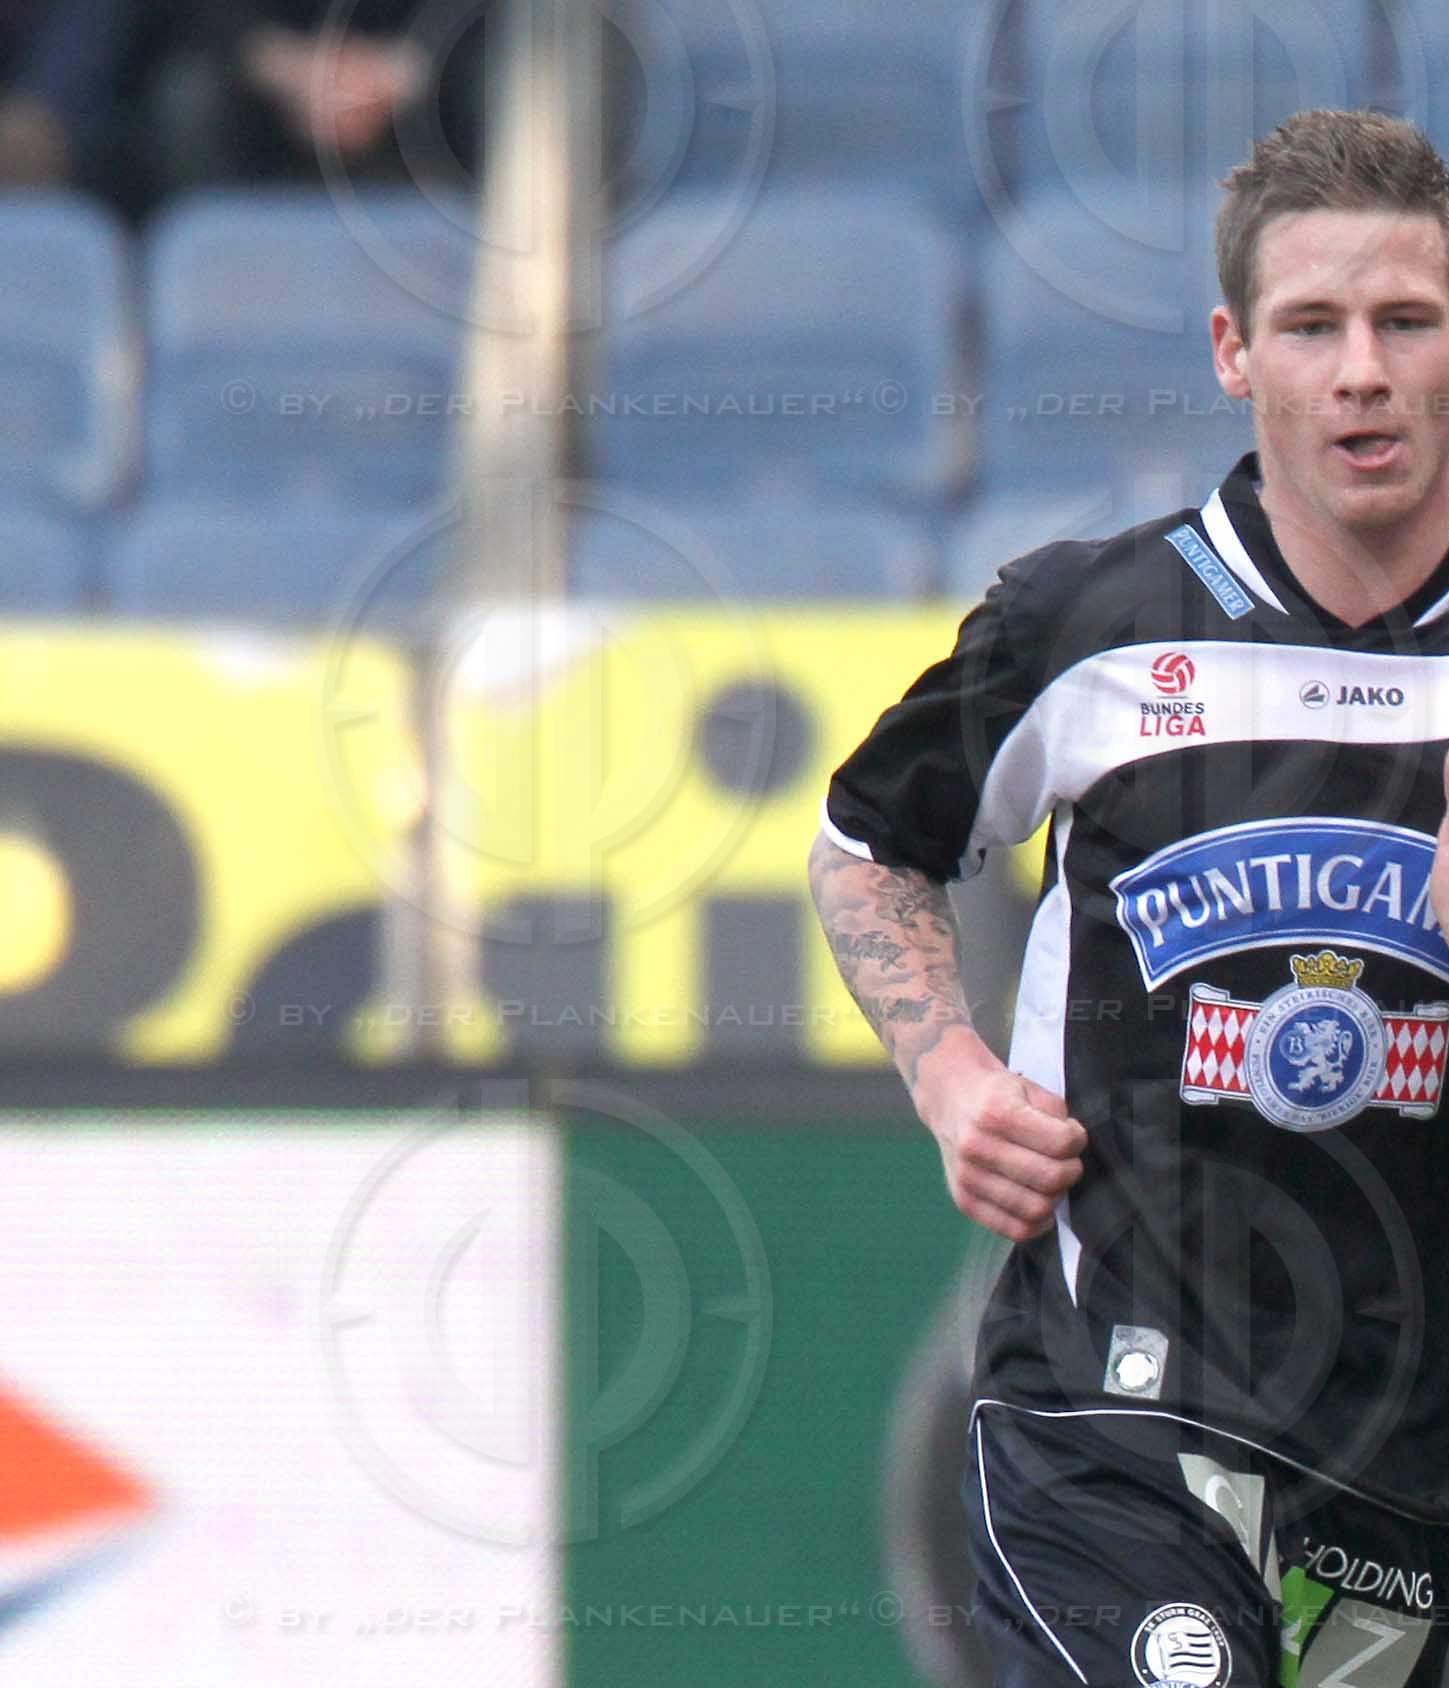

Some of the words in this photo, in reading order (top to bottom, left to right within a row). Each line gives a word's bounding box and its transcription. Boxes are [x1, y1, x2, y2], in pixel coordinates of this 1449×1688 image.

[1336, 685, 1405, 707] JAKO
[1140, 701, 1206, 716] BUNDES
[1139, 715, 1207, 737] LIGA
[1136, 853, 1444, 948] PUNTIGA
